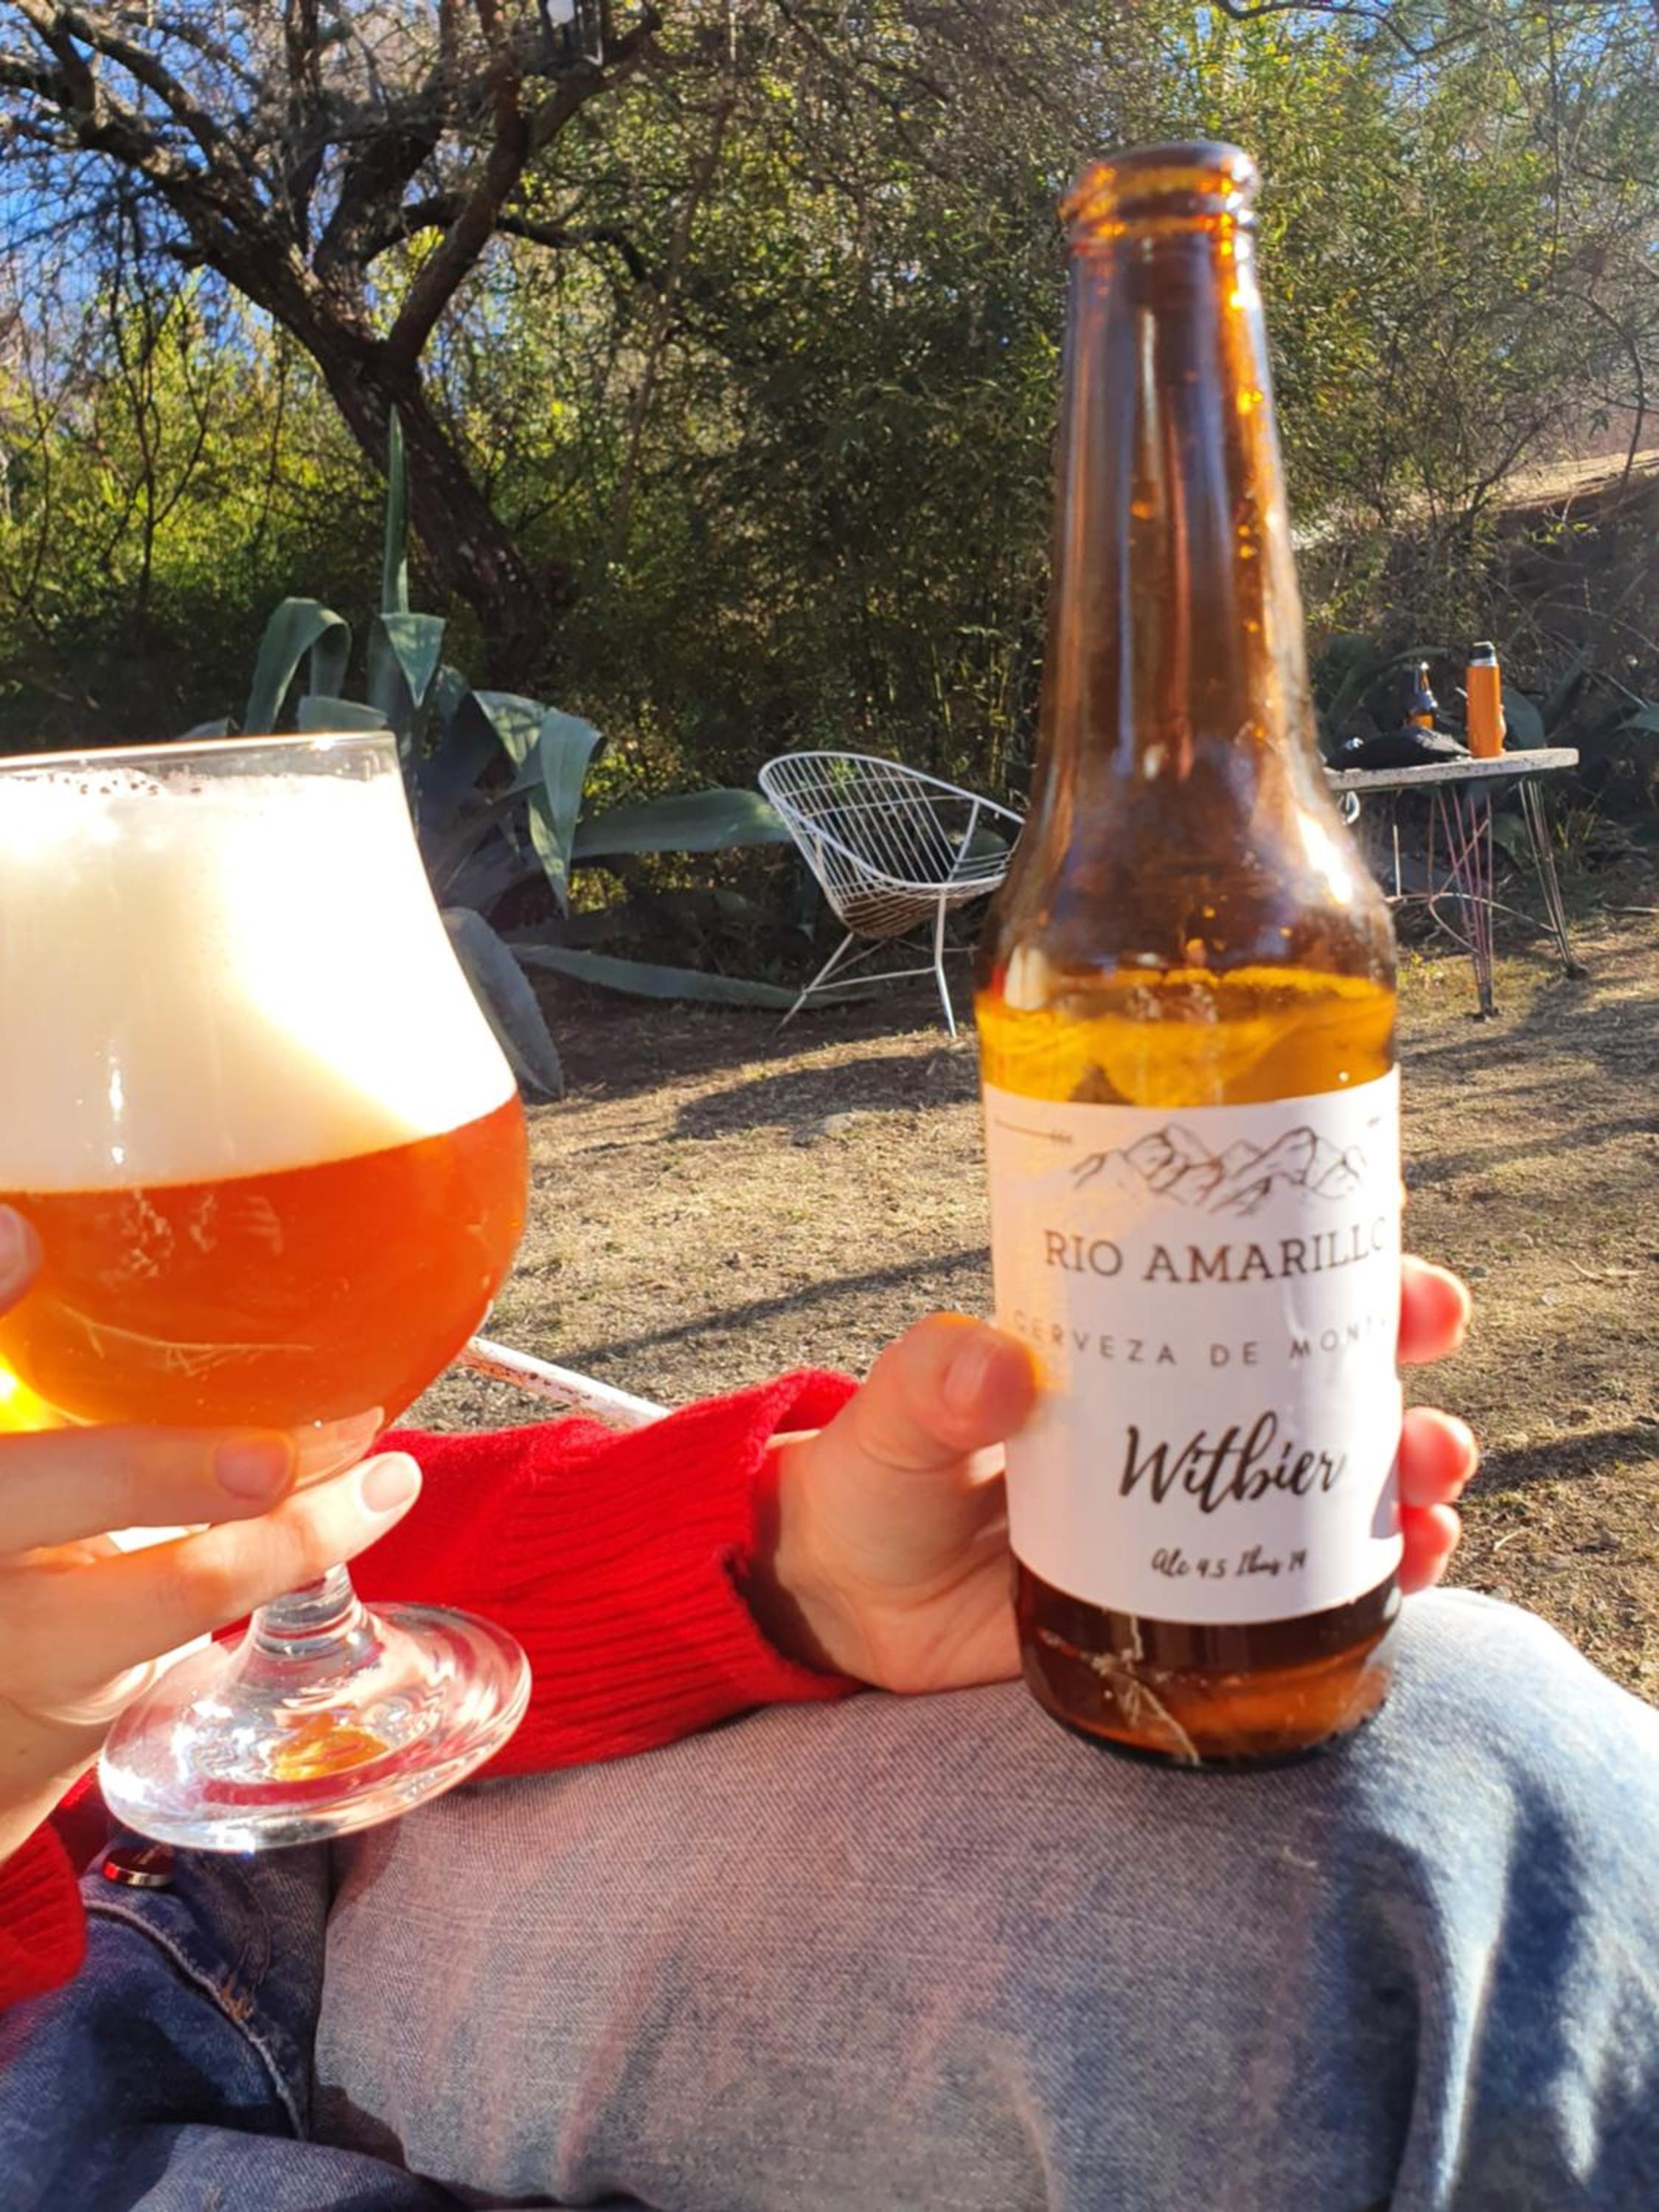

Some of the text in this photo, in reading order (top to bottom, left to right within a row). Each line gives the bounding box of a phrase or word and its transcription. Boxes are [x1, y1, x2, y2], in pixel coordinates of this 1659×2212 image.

[1043, 1229, 1122, 1276] RIO
[1014, 1309, 1178, 1366] CERVEZA
[1210, 1343, 1259, 1367] DE
[1119, 1409, 1346, 1514] Witbier
